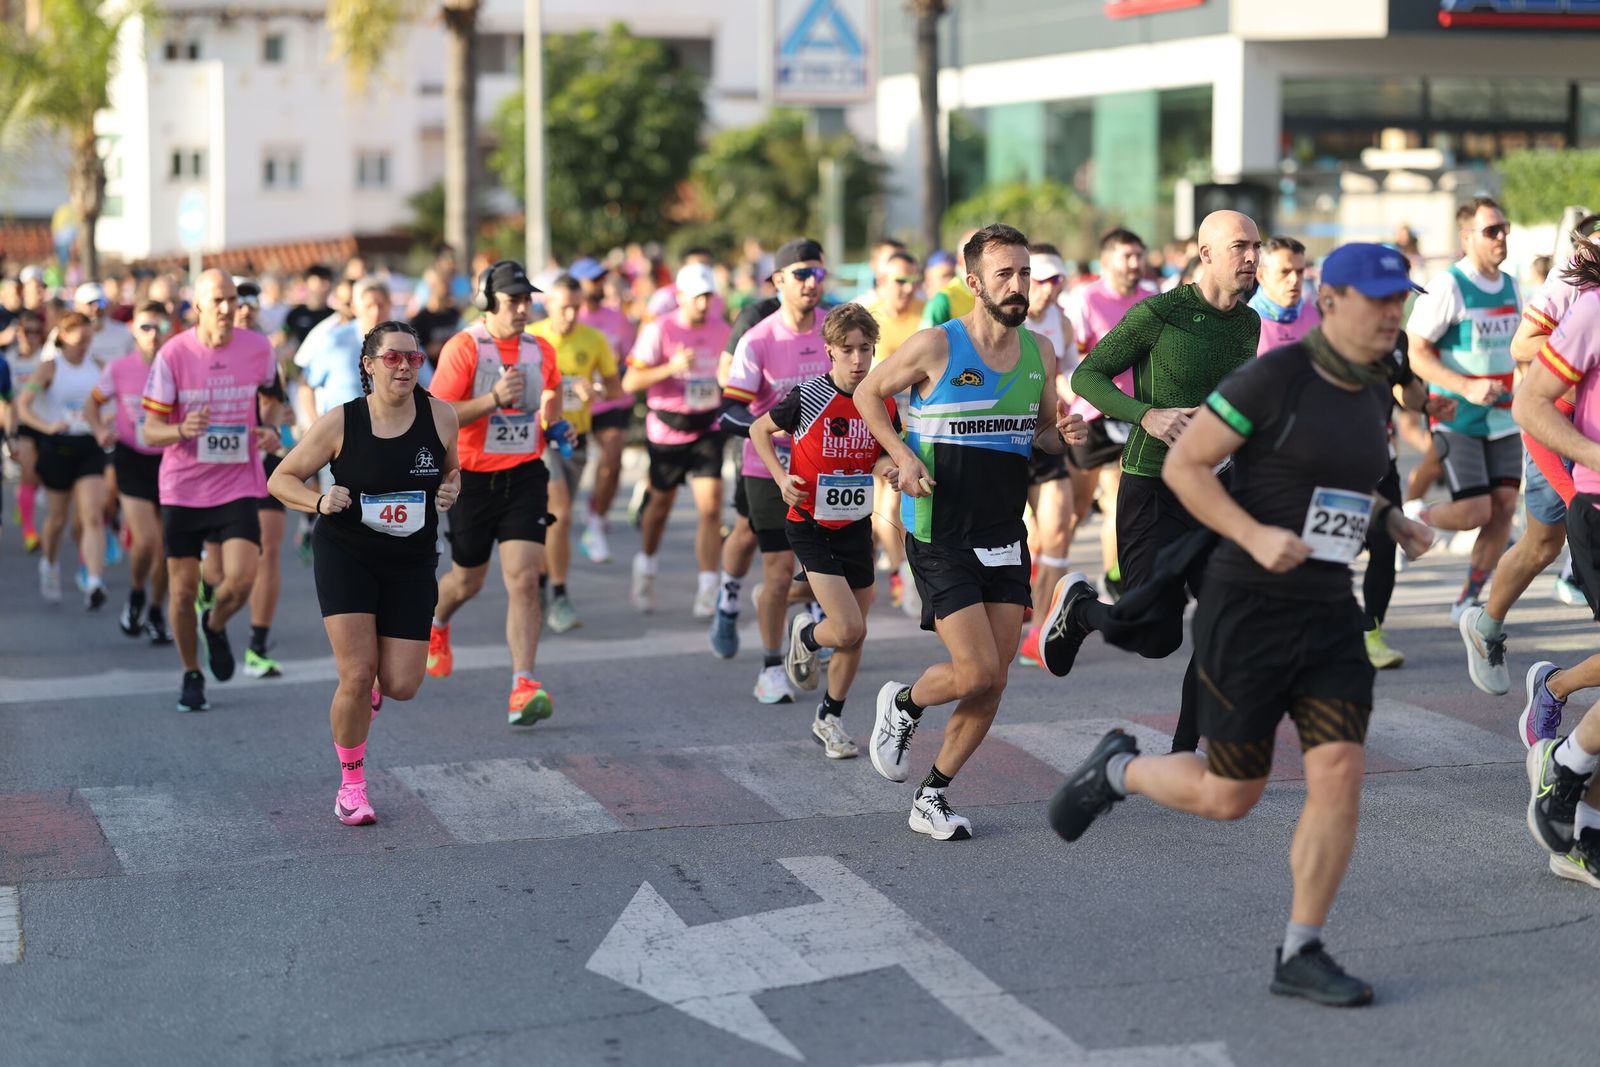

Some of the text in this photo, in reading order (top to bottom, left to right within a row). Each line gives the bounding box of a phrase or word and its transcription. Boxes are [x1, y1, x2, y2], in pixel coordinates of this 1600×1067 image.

[496, 425, 529, 441] 274
[207, 435, 240, 450] 903
[822, 436, 876, 450] RUEDAS
[825, 488, 866, 507] 806
[379, 504, 408, 524] 46
